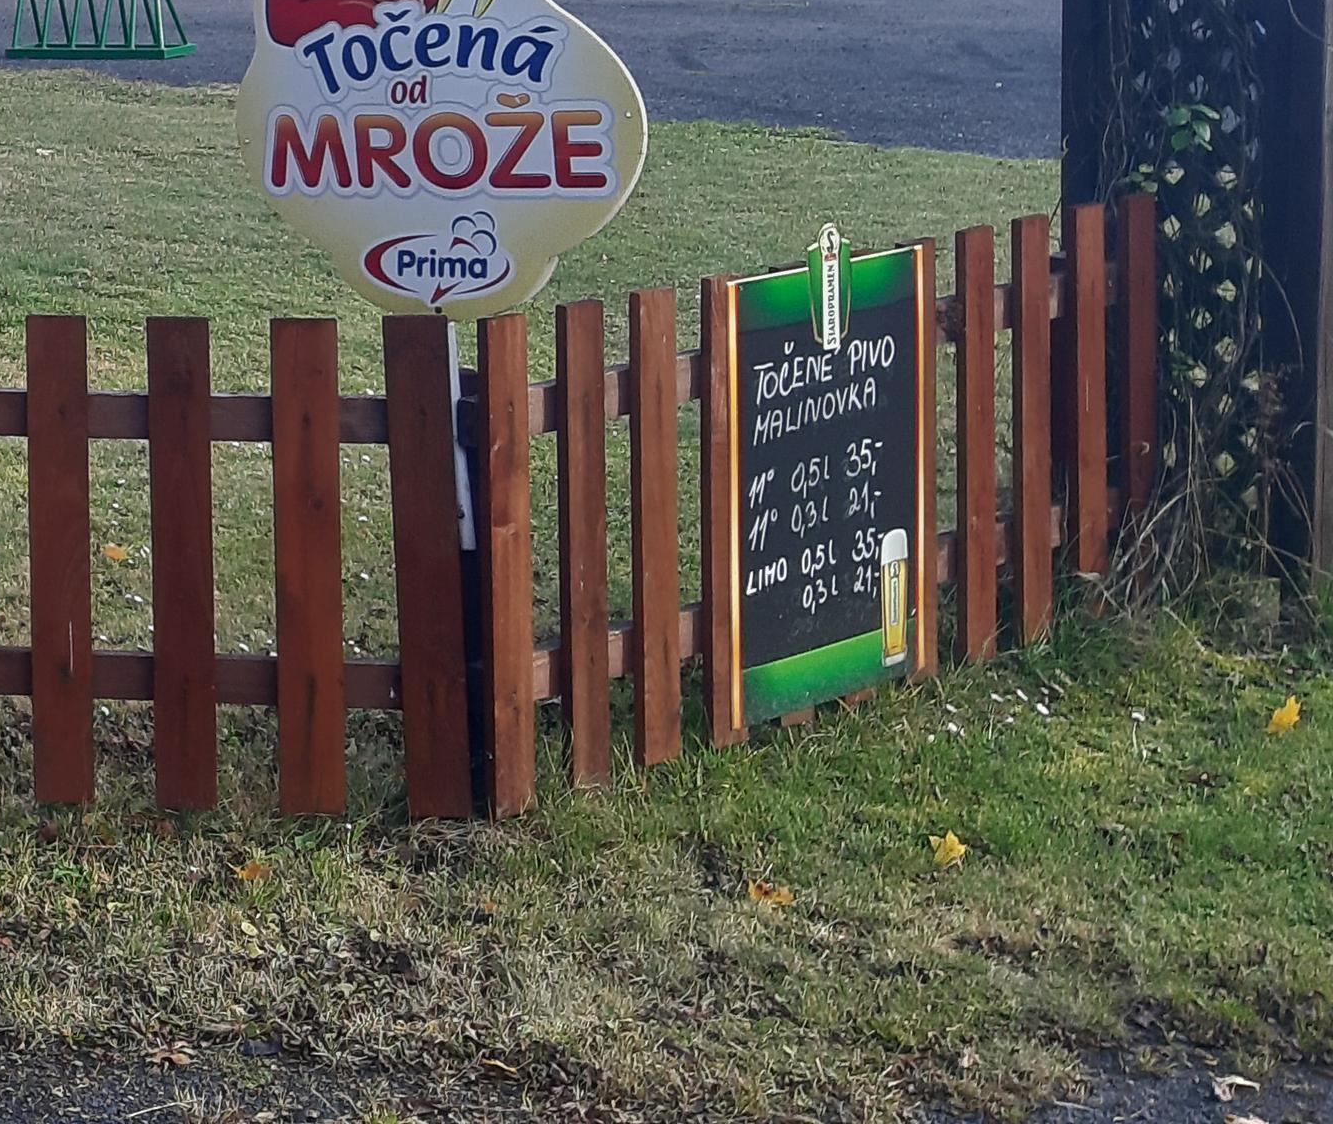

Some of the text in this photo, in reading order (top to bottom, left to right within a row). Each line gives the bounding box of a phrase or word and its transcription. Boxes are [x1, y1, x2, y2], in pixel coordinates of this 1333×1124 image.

[303, 10, 557, 94] Točená
[390, 76, 427, 104] od
[271, 93, 607, 190] MROŽE
[397, 250, 488, 280] Prima
[847, 335, 895, 376] PIVO
[753, 377, 876, 446] MALINOVKA
[746, 557, 788, 596] LIMO
